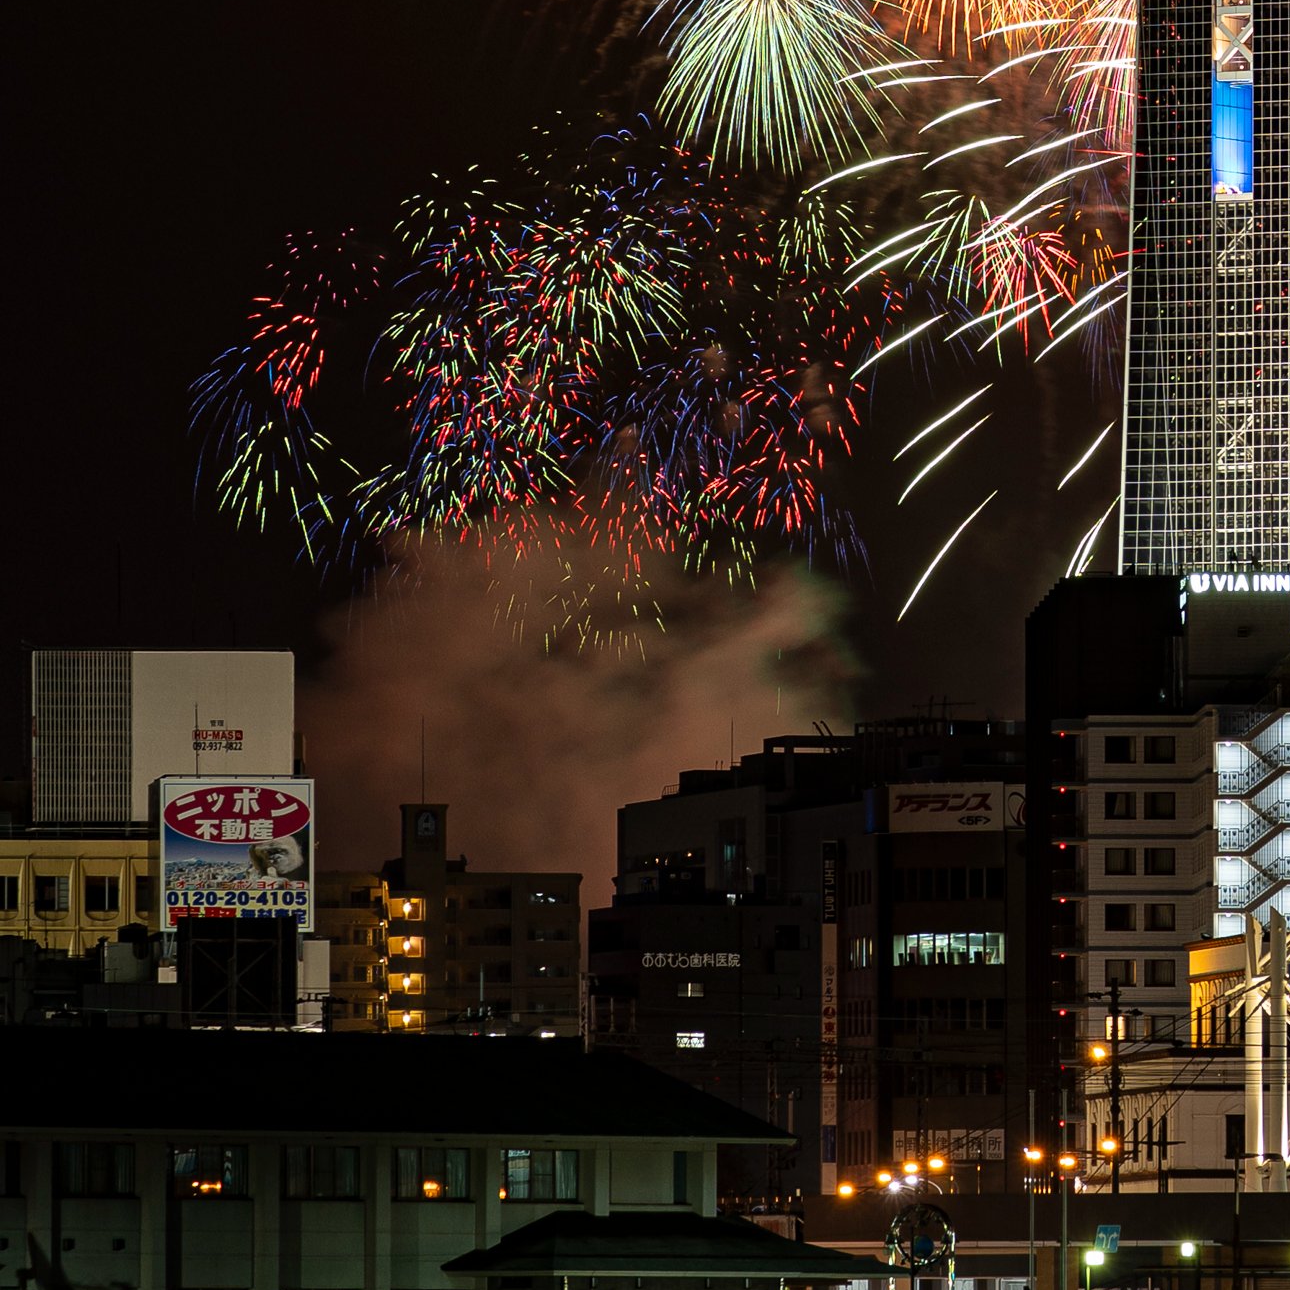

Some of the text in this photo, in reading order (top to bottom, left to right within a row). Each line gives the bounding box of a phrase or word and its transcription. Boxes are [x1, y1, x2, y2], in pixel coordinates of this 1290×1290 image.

[1212, 574, 1290, 591] VIA INN
[175, 787, 299, 821] ニッポン
[195, 819, 274, 840] 不動産
[167, 891, 307, 906] 0120-20-4105
